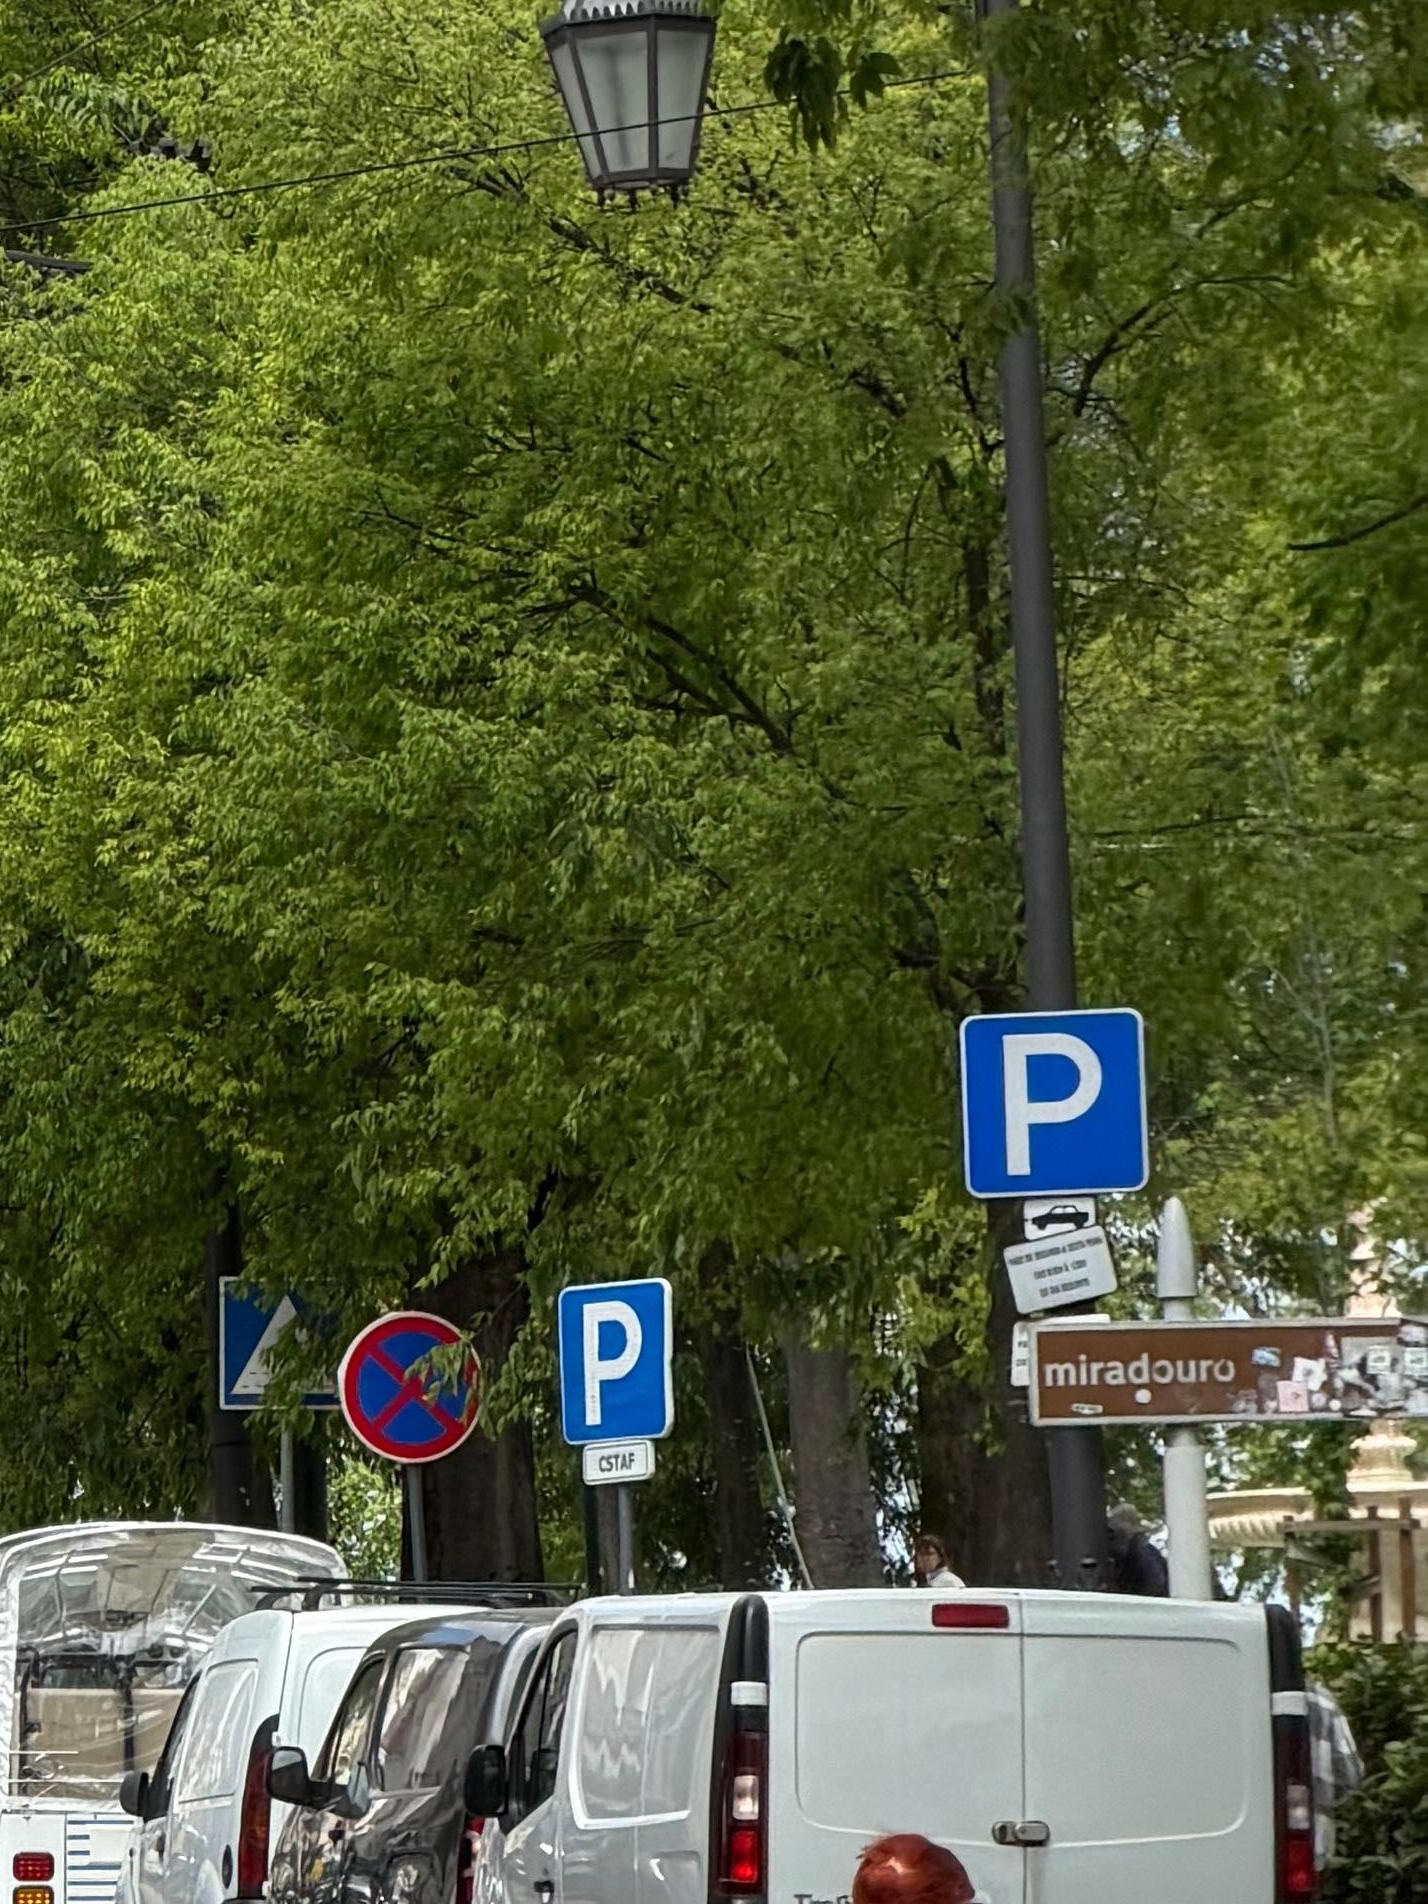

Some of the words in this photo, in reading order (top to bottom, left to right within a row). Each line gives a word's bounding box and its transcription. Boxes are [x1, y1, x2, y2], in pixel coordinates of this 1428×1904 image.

[1001, 1032, 1104, 1177] P
[582, 1299, 643, 1426] P
[1044, 1352, 1236, 1388] miradouro
[598, 1452, 636, 1473] CSTAF
